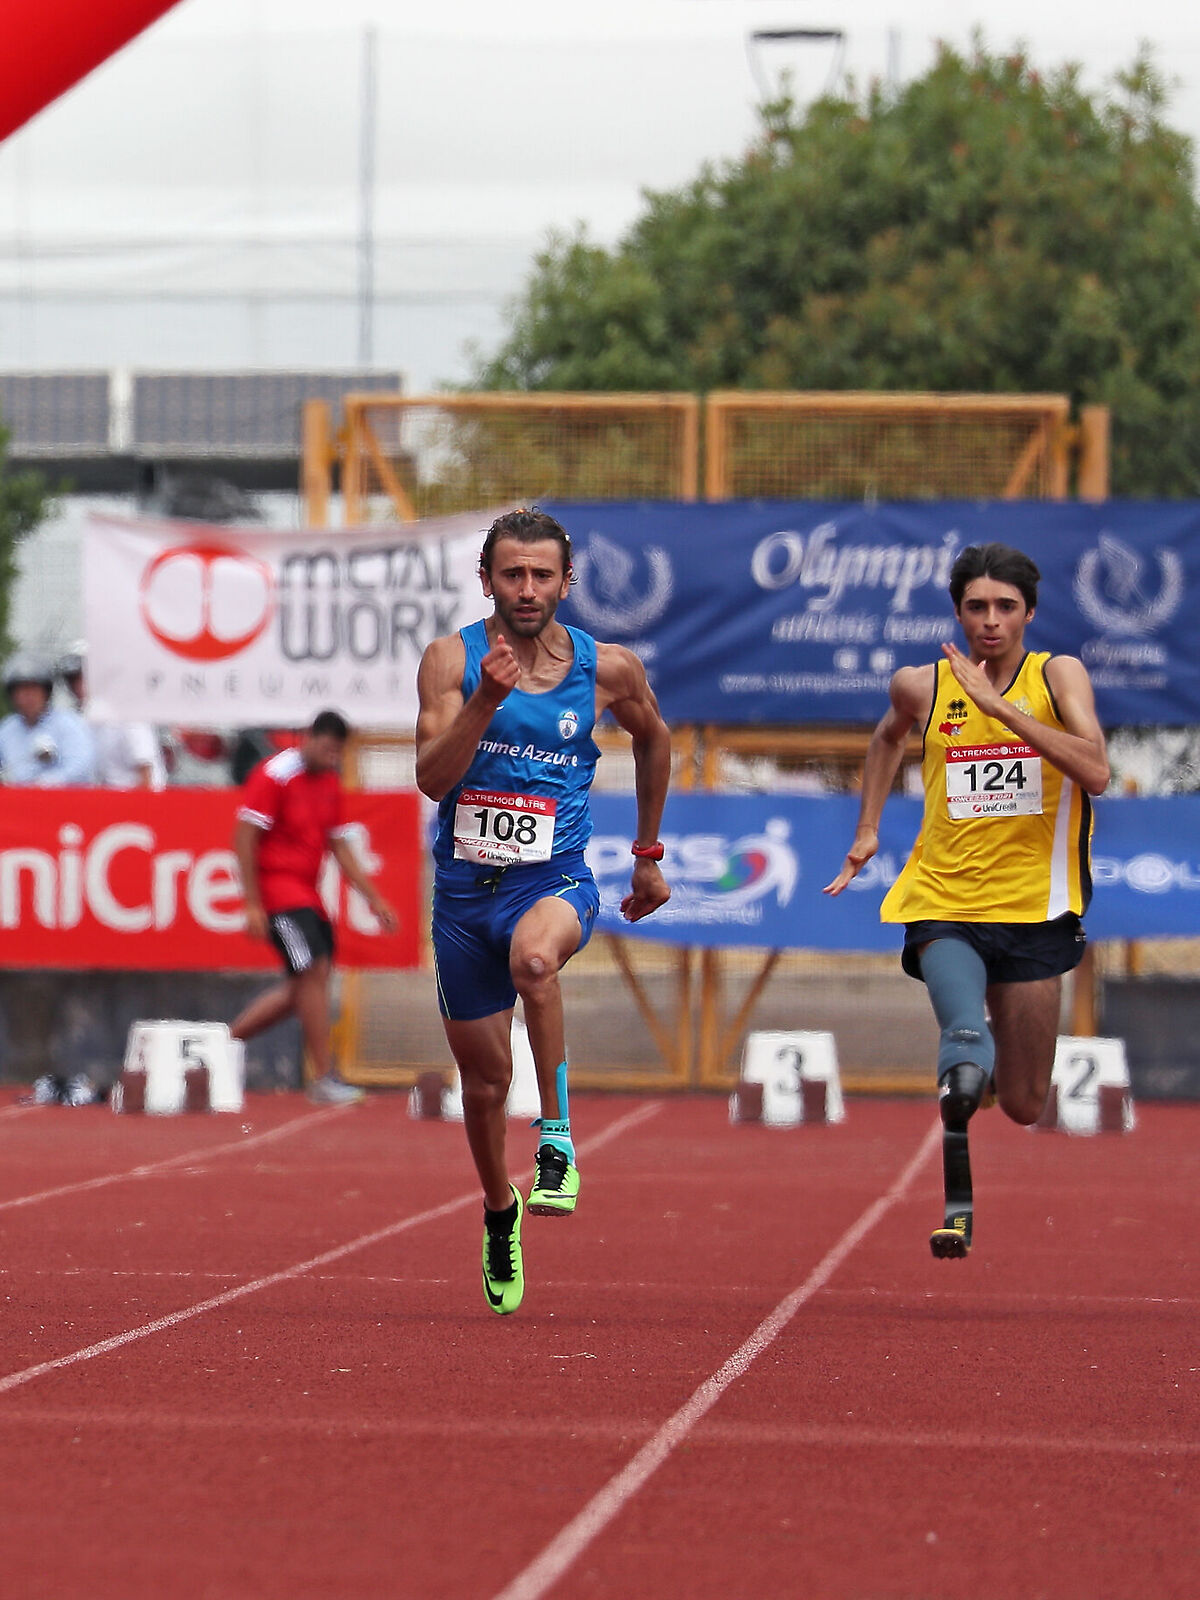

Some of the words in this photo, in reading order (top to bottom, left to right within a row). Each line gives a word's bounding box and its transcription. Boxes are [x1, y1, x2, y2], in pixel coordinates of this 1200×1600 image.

[751, 521, 960, 612] Olympi
[280, 600, 462, 662] WORK
[478, 739, 521, 757] mme
[963, 760, 1027, 792] 124
[982, 802, 1017, 813] UniCredit
[474, 808, 537, 845] 108
[1065, 1054, 1098, 1099] 2
